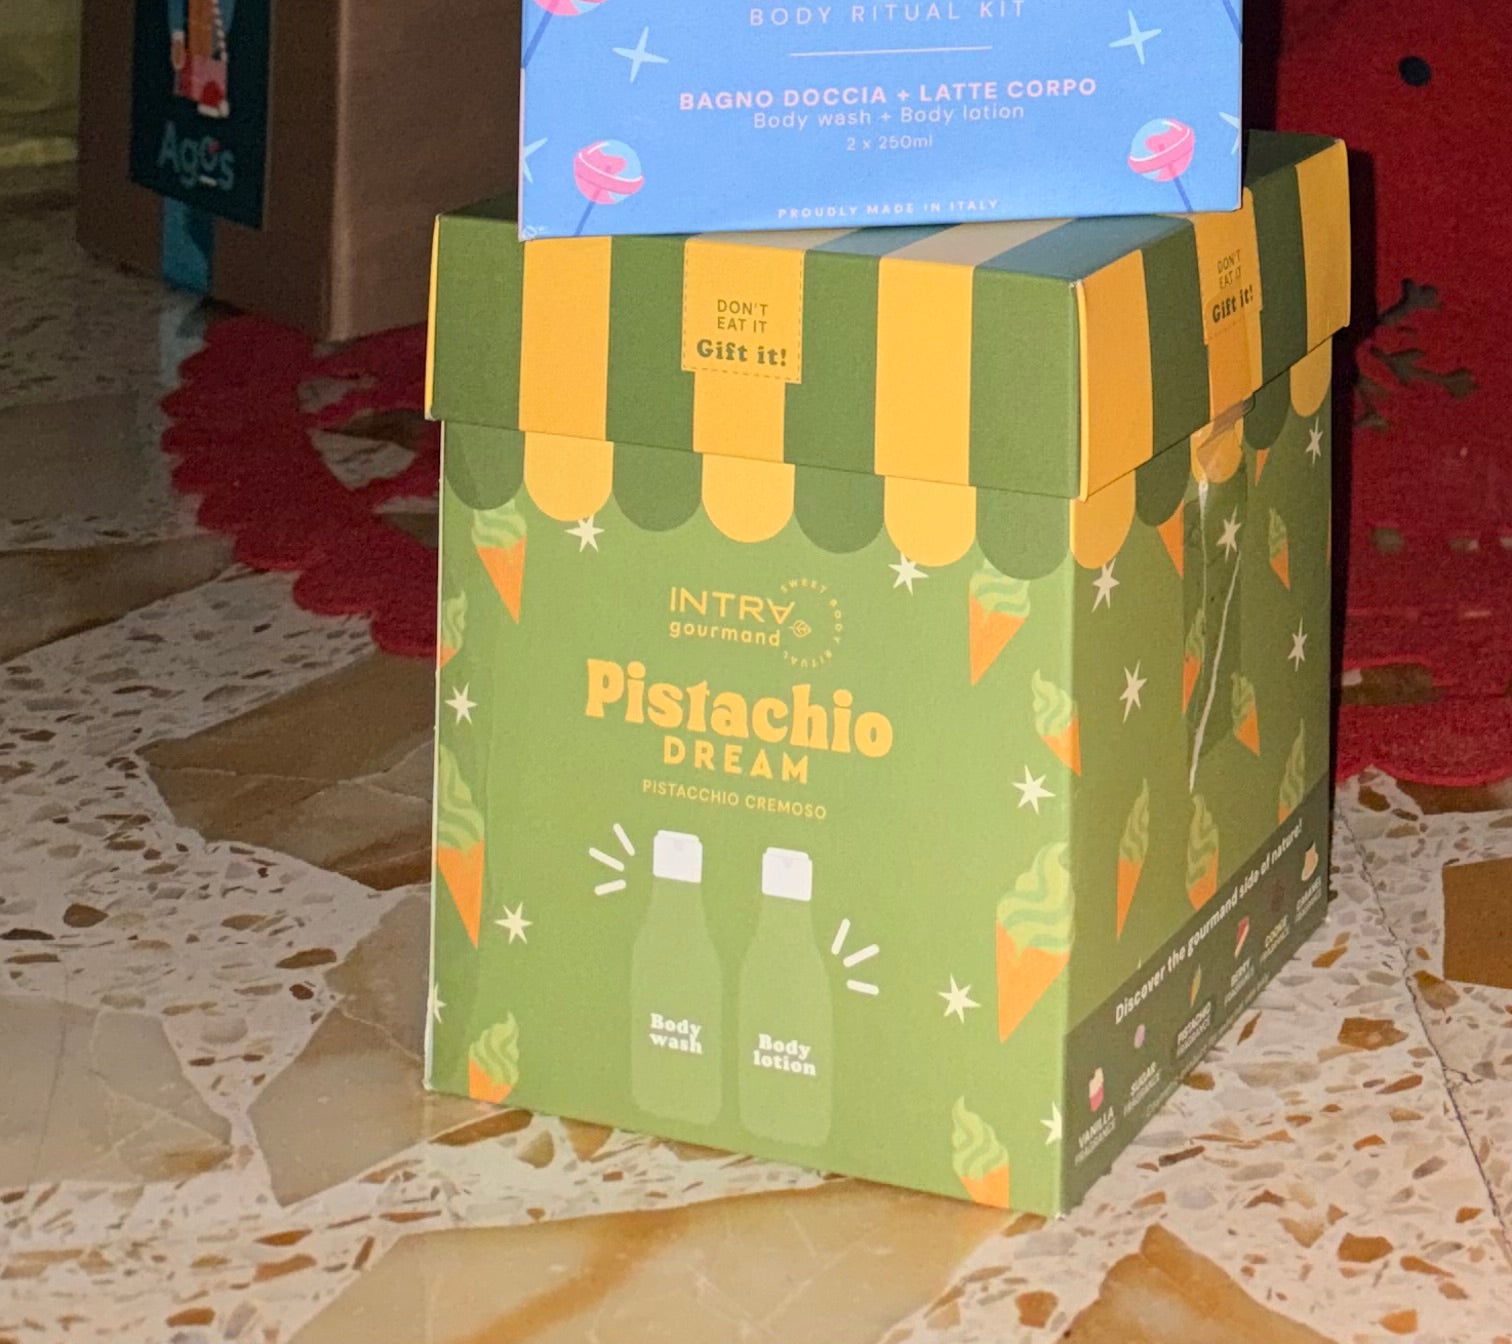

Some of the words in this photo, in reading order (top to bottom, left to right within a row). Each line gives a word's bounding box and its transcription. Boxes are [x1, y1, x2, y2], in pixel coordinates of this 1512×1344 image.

[749, 6, 832, 26] BODY
[851, 1, 960, 23] RITUAL
[980, 0, 1026, 18] KIT
[680, 91, 774, 110] BAGNO
[783, 86, 886, 107] DOCCIA
[898, 90, 909, 101] +
[920, 83, 997, 102] LATTE
[1007, 78, 1097, 98] CORPO
[753, 112, 808, 131] Body
[818, 110, 871, 126] wash
[882, 112, 891, 121] +
[900, 106, 954, 126] Body
[963, 103, 1025, 120] lotion
[158, 120, 235, 191] Agos
[846, 137, 856, 151] 2
[863, 140, 871, 150] x
[878, 135, 933, 150] 250ml
[778, 206, 857, 219] PROUDLY
[867, 204, 914, 215] MADE
[924, 202, 940, 212] IN
[949, 200, 999, 211] ITALY
[717, 299, 768, 316] DON'T
[1212, 295, 1237, 323] Gift
[1240, 284, 1253, 308] it!
[717, 316, 746, 331] EAT
[753, 320, 767, 333] IT
[697, 339, 748, 362] Gift
[757, 346, 786, 366] it!
[780, 578, 829, 594] SWEET
[669, 620, 781, 647] gourmand
[585, 658, 894, 758] Pistachio
[663, 735, 809, 785] DREAM
[642, 779, 740, 806] PISTACCHIO
[745, 794, 827, 820] CREMOSO
[1115, 964, 1166, 1025] Discover
[1168, 945, 1186, 973] the
[1187, 887, 1238, 957] gourmand
[1239, 869, 1259, 901] side
[1260, 854, 1270, 874] of
[650, 1012, 702, 1039] Body
[649, 1032, 703, 1055] wash
[758, 1033, 811, 1061] Body
[753, 1050, 817, 1076] lotion
[1078, 1106, 1115, 1148] VANILLA
